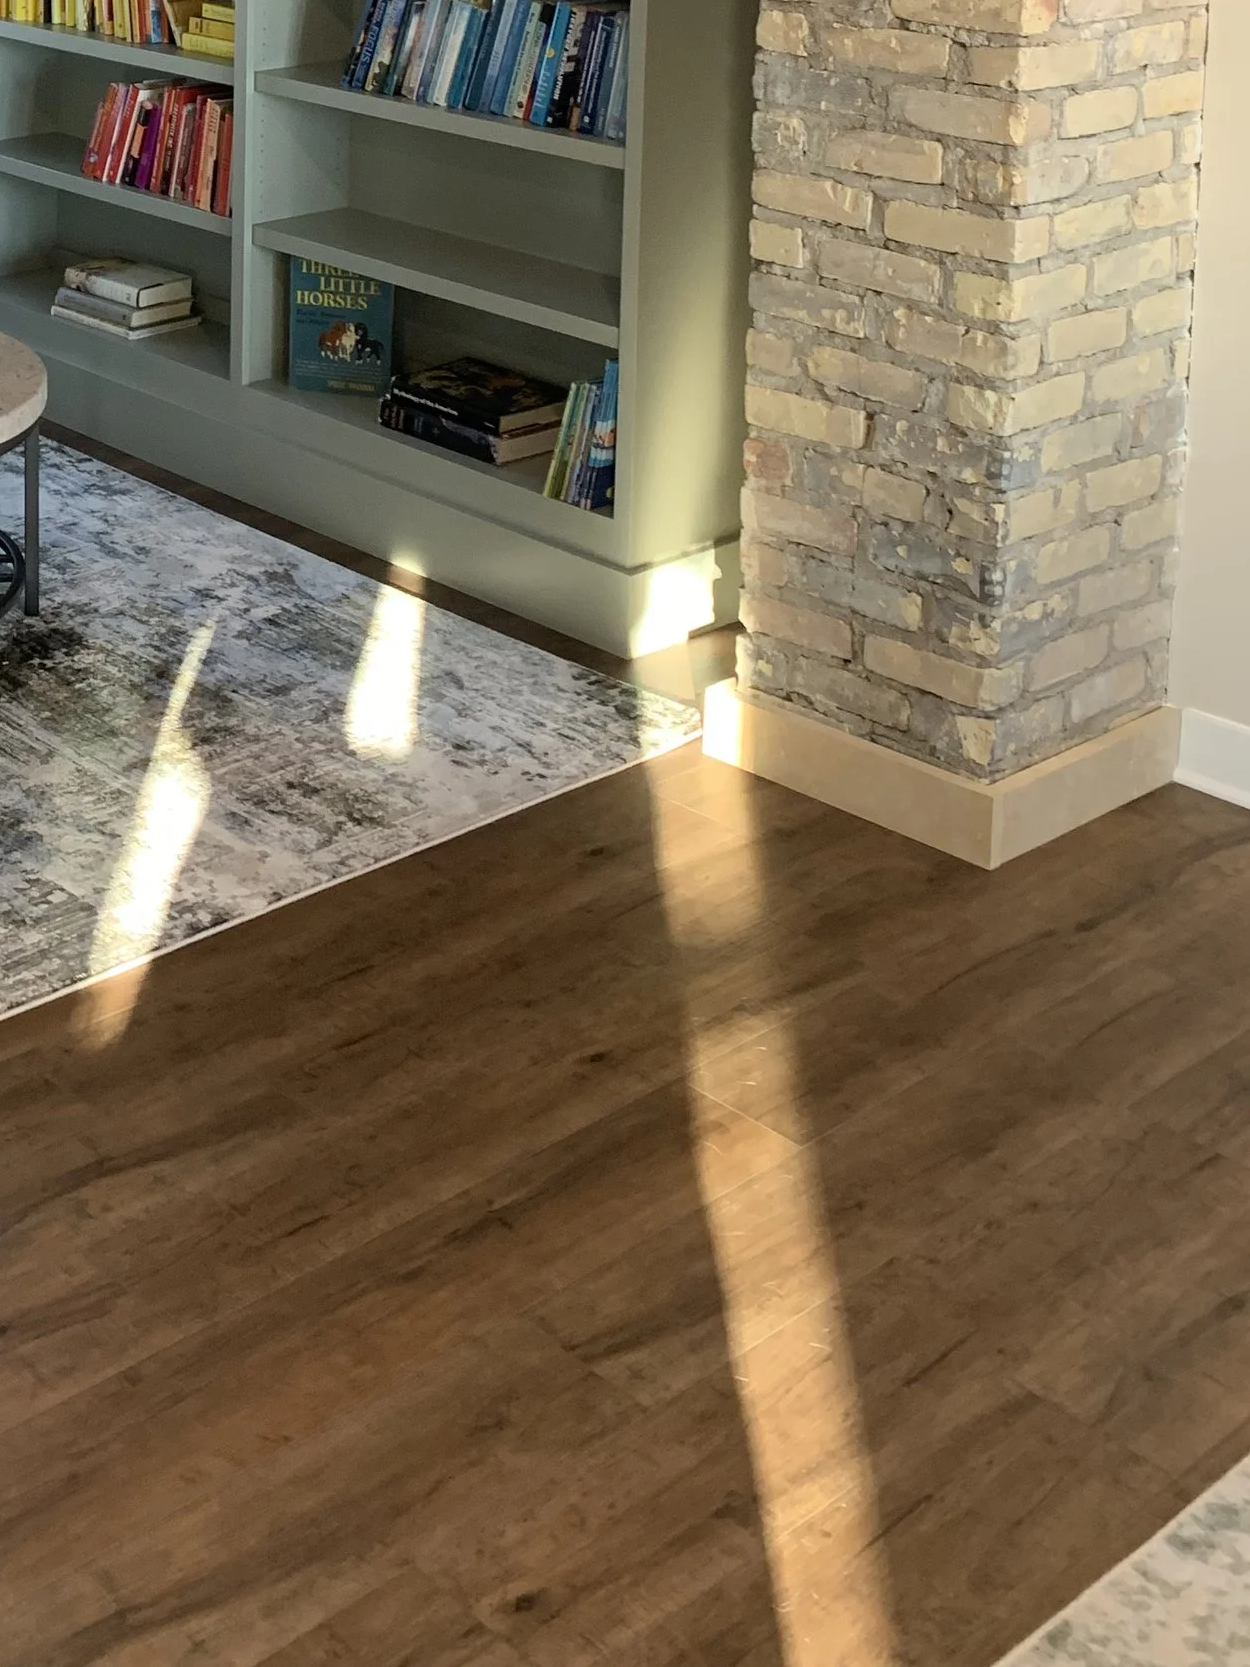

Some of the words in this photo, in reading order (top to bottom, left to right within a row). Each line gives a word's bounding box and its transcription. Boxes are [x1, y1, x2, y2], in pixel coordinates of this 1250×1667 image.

[361, 25, 379, 63] FOCUS
[301, 259, 359, 278] THR
[319, 276, 382, 295] LITTLE
[296, 290, 368, 310] HORSES
